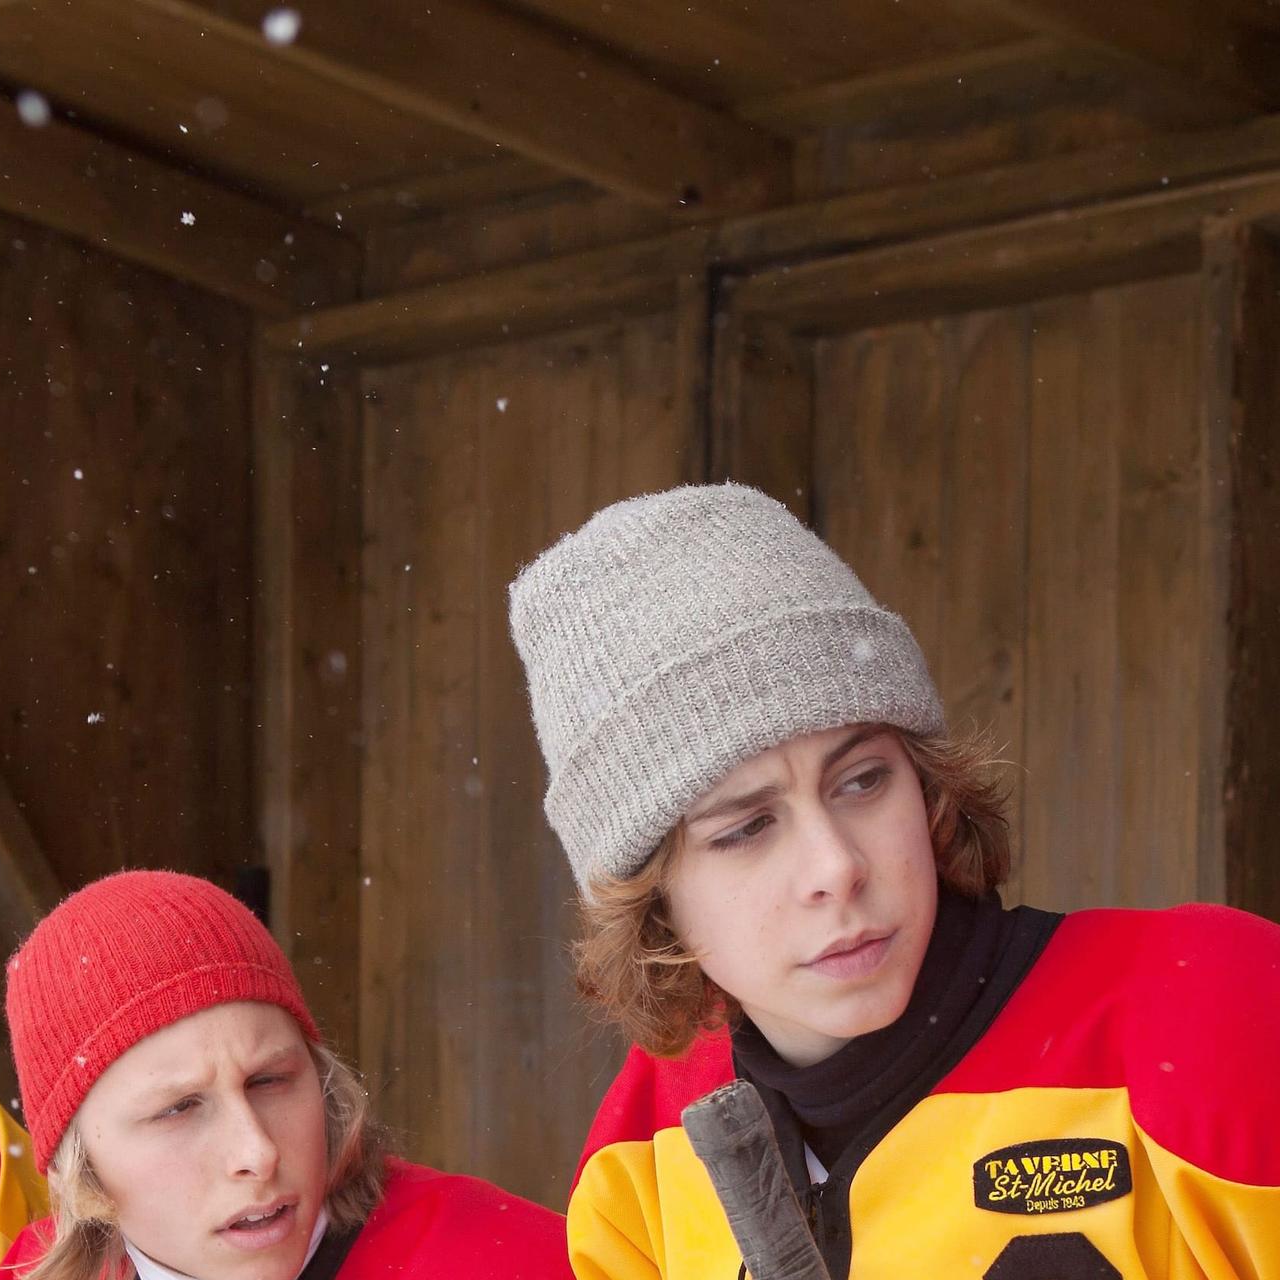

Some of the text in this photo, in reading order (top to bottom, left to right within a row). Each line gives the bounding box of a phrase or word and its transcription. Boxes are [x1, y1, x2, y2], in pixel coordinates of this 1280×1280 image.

[984, 1149, 1118, 1179] TAVERNE
[988, 1164, 1118, 1201] St-Michel
[1026, 1195, 1085, 1213] Depuis 1943
